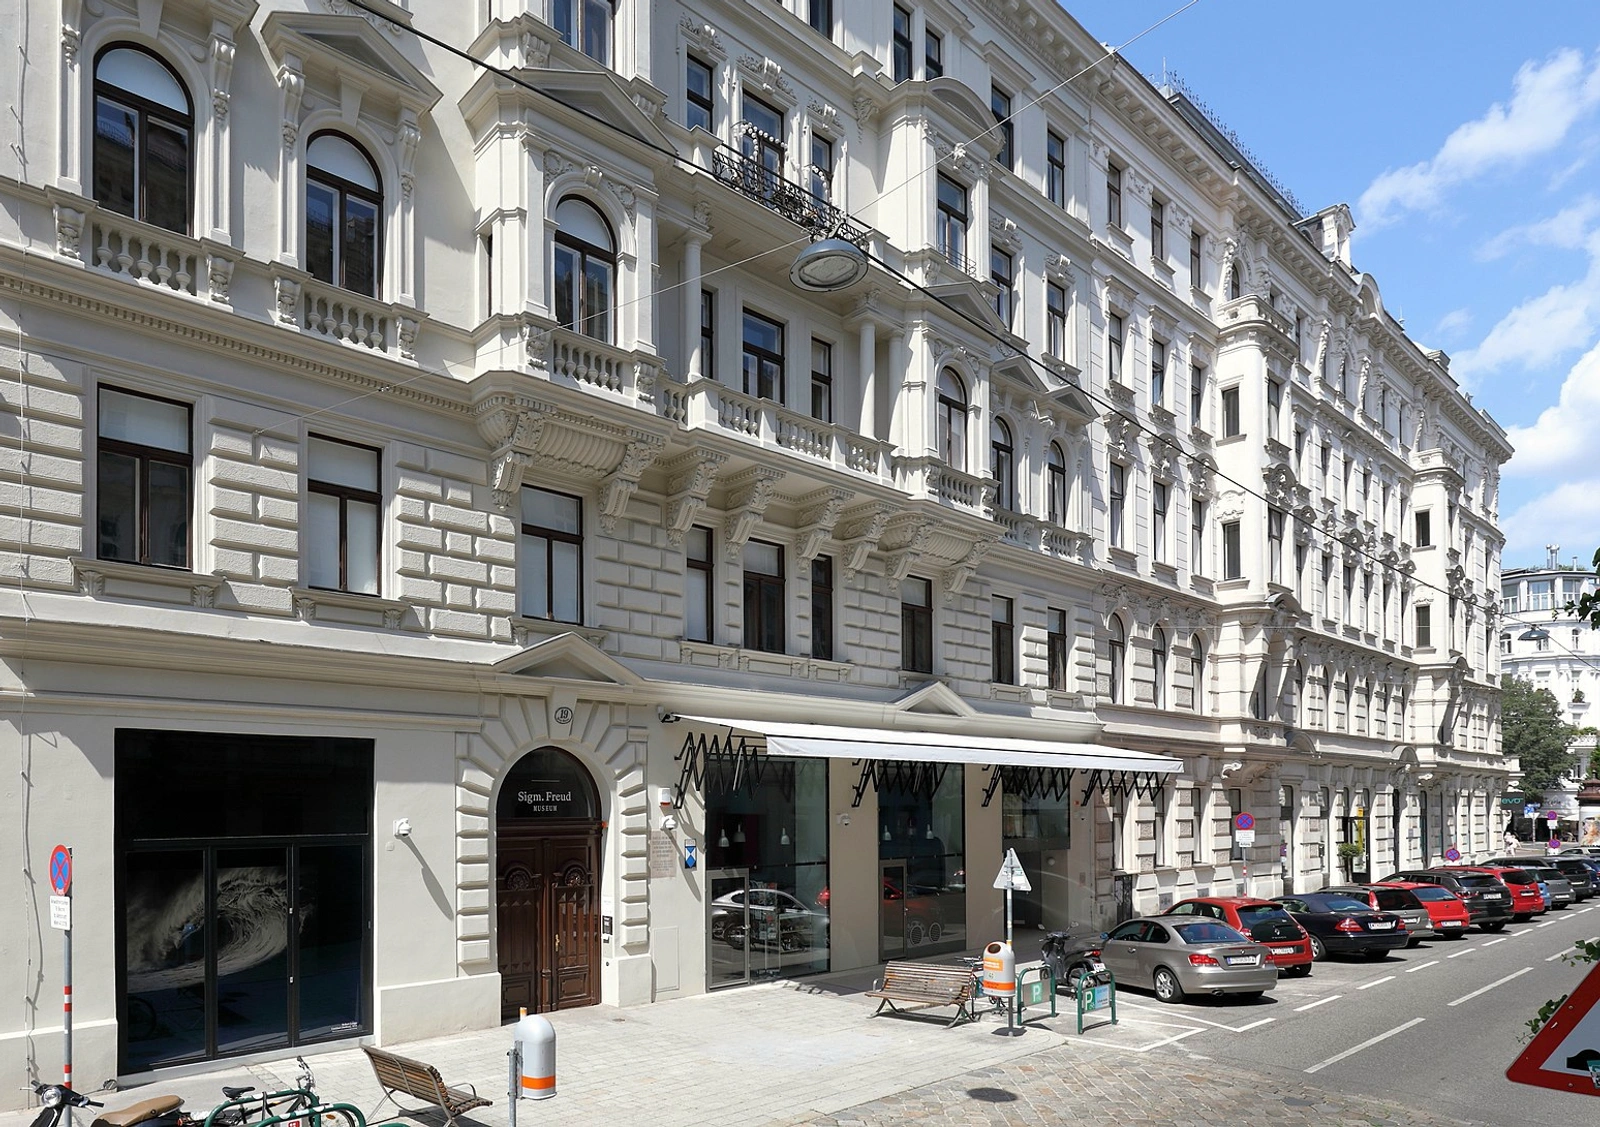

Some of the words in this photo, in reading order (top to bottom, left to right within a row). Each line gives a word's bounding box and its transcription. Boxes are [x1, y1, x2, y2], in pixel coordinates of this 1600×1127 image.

[560, 709, 569, 719] 19
[517, 791, 545, 804] Sigm.
[545, 791, 572, 801] Freud
[1033, 984, 1041, 1002] P
[1085, 991, 1093, 1011] P
